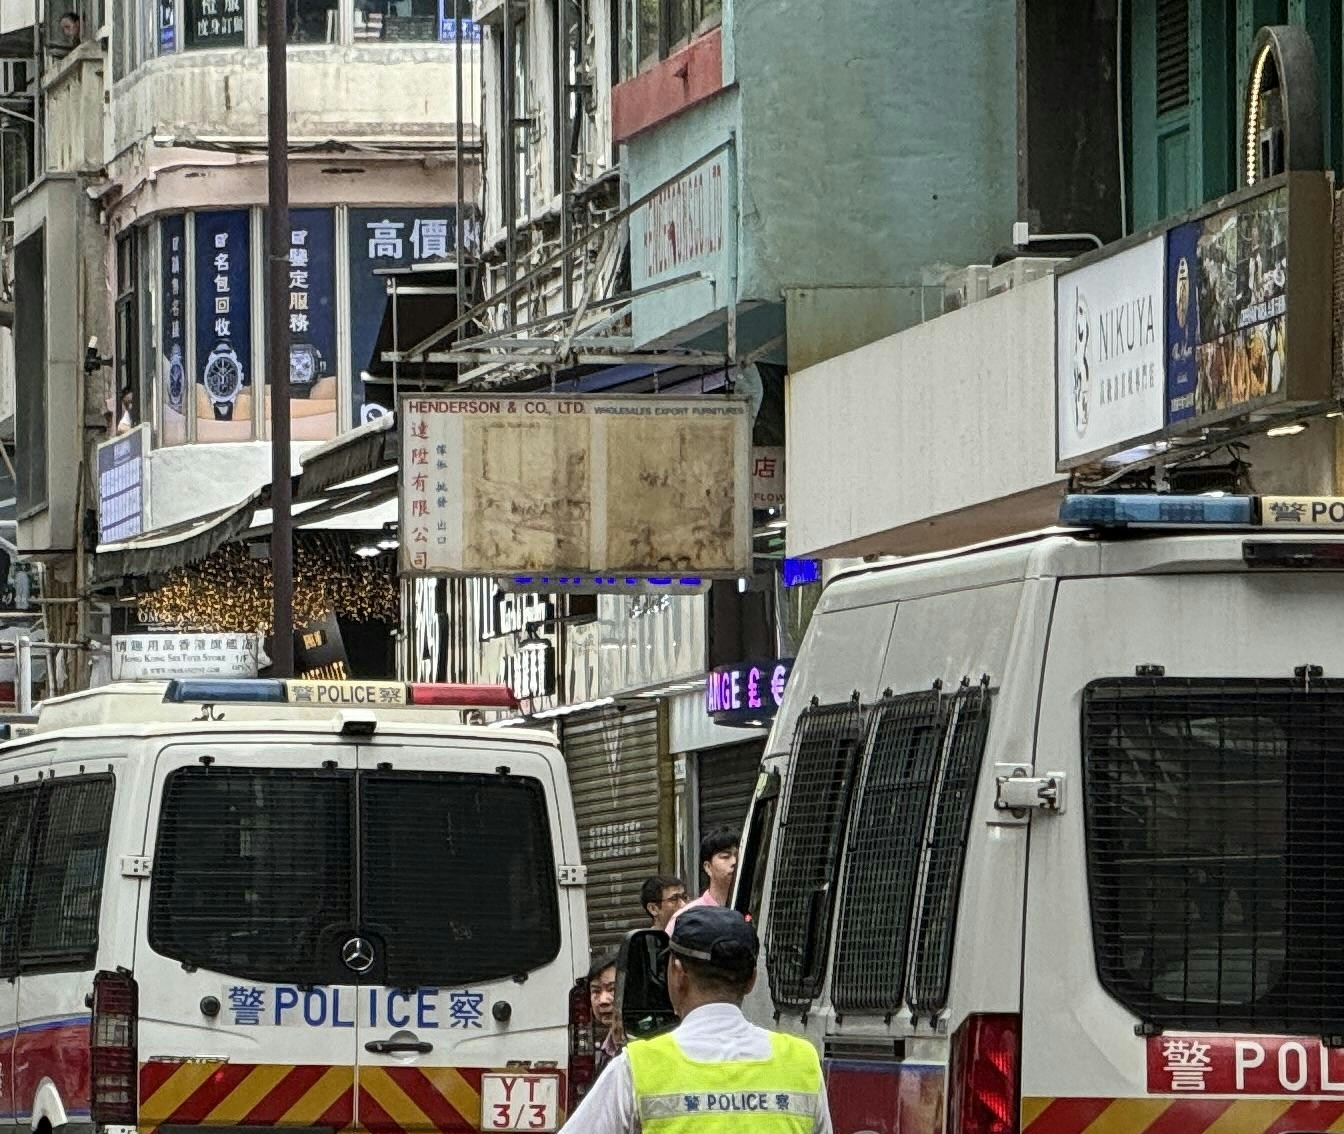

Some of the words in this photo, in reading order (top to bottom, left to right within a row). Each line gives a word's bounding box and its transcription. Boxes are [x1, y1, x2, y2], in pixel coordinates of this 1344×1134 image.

[214, 253, 231, 337] 名包回收
[1099, 294, 1155, 362] NIKUYA
[409, 401, 500, 415] HENDERSON
[507, 401, 516, 414] &
[317, 686, 376, 703] POLICE
[380, 687, 401, 702] 察
[227, 986, 265, 1024] 警
[274, 987, 439, 1028] POLICE
[449, 991, 484, 1028] 察
[1162, 1039, 1213, 1090] 警
[500, 1077, 540, 1102] YT
[707, 1093, 768, 1111] POLICE
[775, 1094, 790, 1111] 察
[493, 1104, 546, 1128] 3/3
